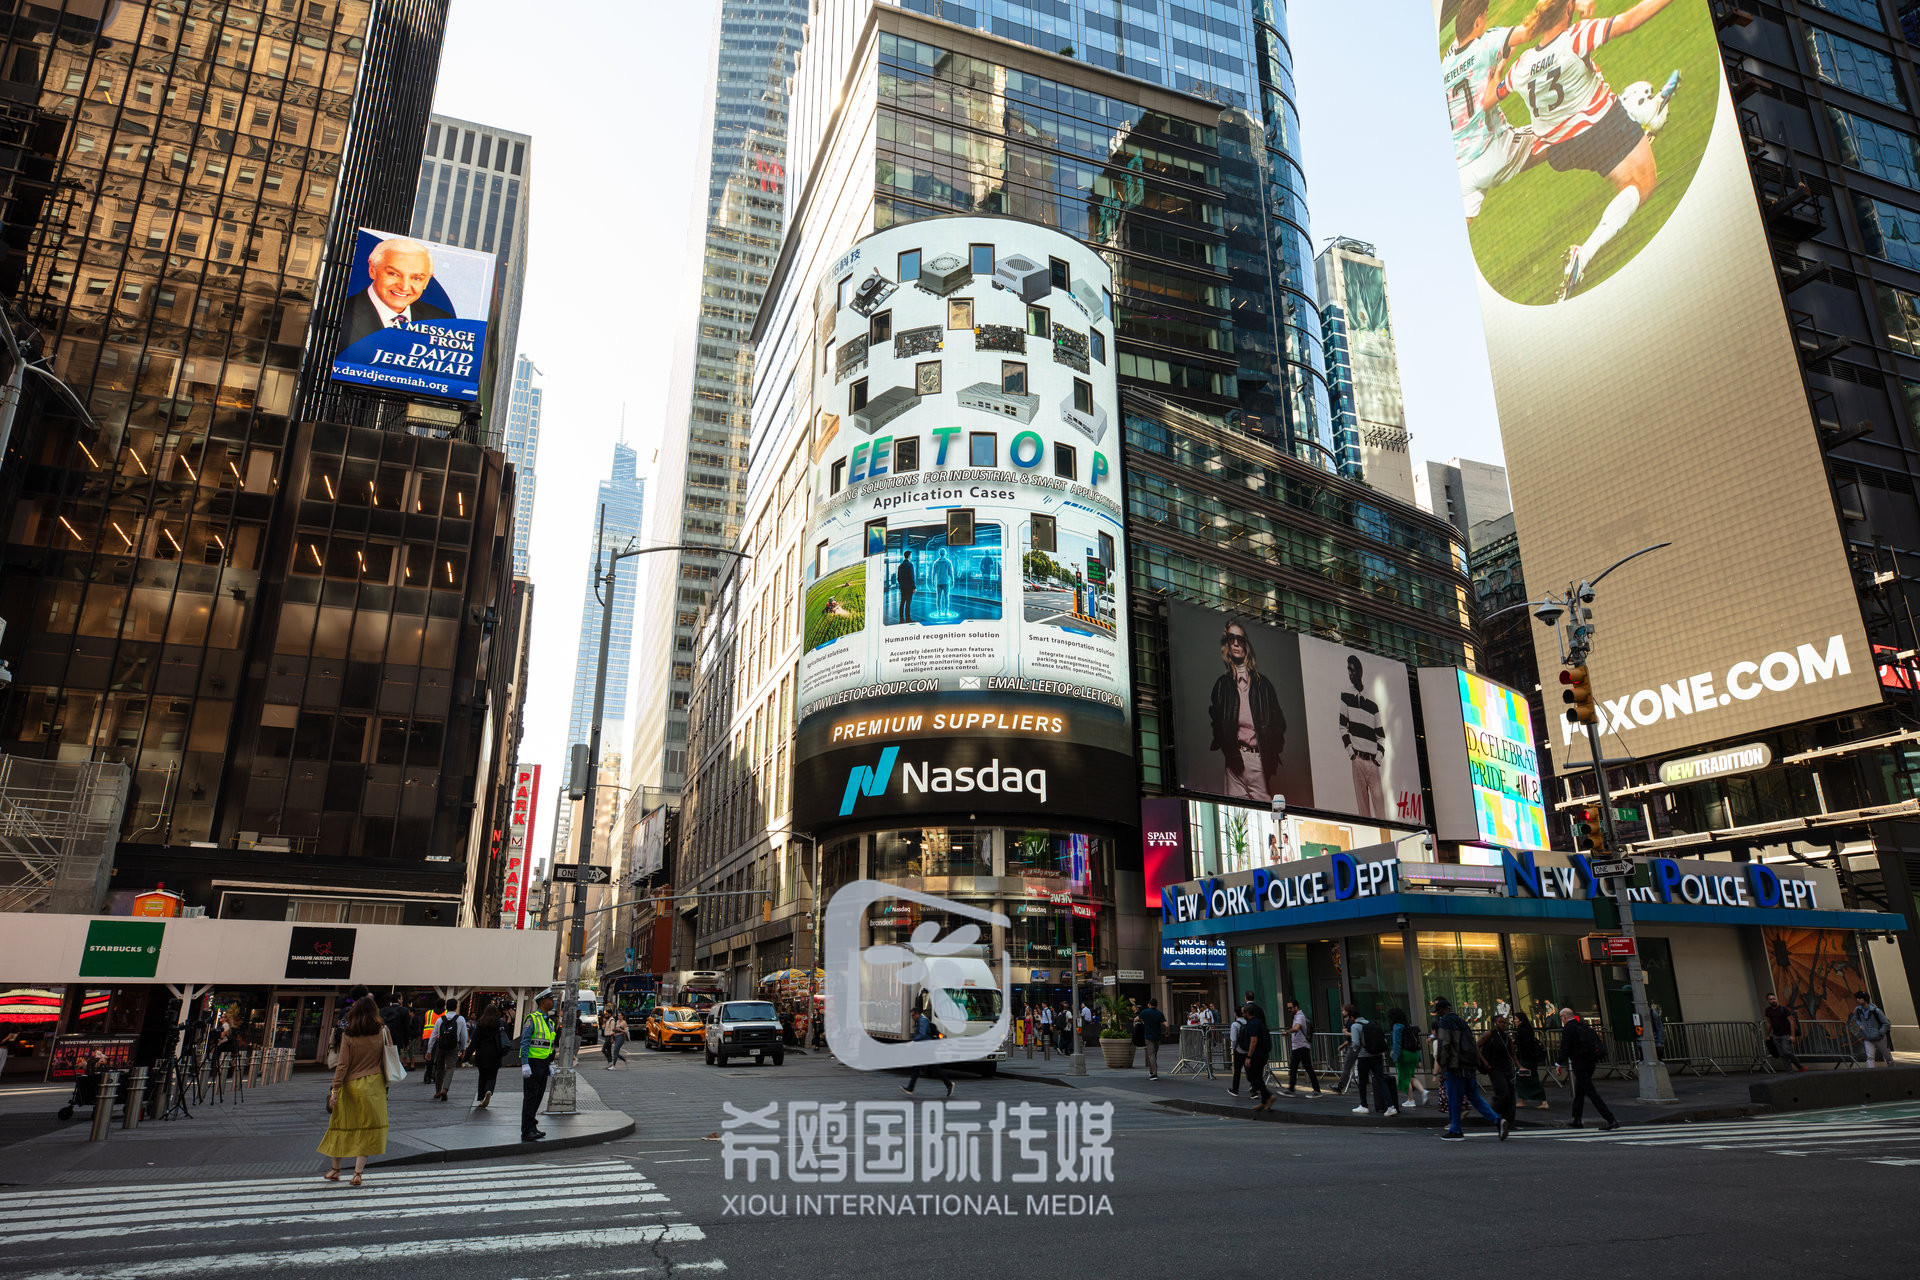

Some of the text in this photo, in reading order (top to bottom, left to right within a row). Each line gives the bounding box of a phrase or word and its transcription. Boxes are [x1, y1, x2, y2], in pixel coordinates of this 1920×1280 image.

[1531, 53, 1555, 76] REAM
[1527, 66, 1565, 118] 13
[391, 318, 476, 342] A MESSAGE
[409, 342, 474, 365] DAVID
[429, 335, 474, 352] FROM
[369, 349, 472, 377] JEREMIAH
[860, 473, 920, 497] SOLUTIONS
[923, 470, 948, 484] FOR
[949, 469, 1018, 483] INDUSTRIAL
[1020, 472, 1030, 485] &
[1030, 474, 1068, 492] SMART
[1070, 483, 1123, 517] APPLICATIONS
[873, 486, 1016, 510] Application Cases
[884, 634, 921, 644] Humanoid
[922, 632, 966, 641] recognition
[1029, 635, 1115, 657] Smart transportation solution
[890, 648, 920, 657] Accurately
[900, 655, 917, 663] apply
[1037, 656, 1058, 664] parking
[1059, 658, 1090, 669] management
[1039, 650, 1064, 659] Integrate
[1031, 661, 1054, 669] enhance
[1073, 667, 1094, 676] operation
[813, 678, 940, 713] WWW.LEETOPGROUP.COM
[987, 676, 1124, 708] EMAIL: LEETOP@LEETOP.CN
[833, 713, 1063, 742] PREMIUM SUPPLIERS
[902, 758, 1047, 804] Nasdaq
[1471, 759, 1509, 795] PRIDE
[513, 772, 531, 825] PARK
[1397, 790, 1422, 822] H&M
[1147, 831, 1177, 840] SPAIN
[561, 869, 578, 877] ONE
[1502, 848, 1576, 898] NEW
[1654, 858, 1750, 906] POLICE
[1747, 864, 1817, 909] DEPT
[1595, 863, 1629, 875] ONE WAY
[503, 857, 521, 912] PARK
[1161, 853, 1398, 924] NEW YORK POLICE DEPT
[1026, 906, 1047, 914] Nasdaq
[89, 945, 142, 953] STARBUCKS
[1163, 947, 1227, 956] NEIGHBORHOOD
